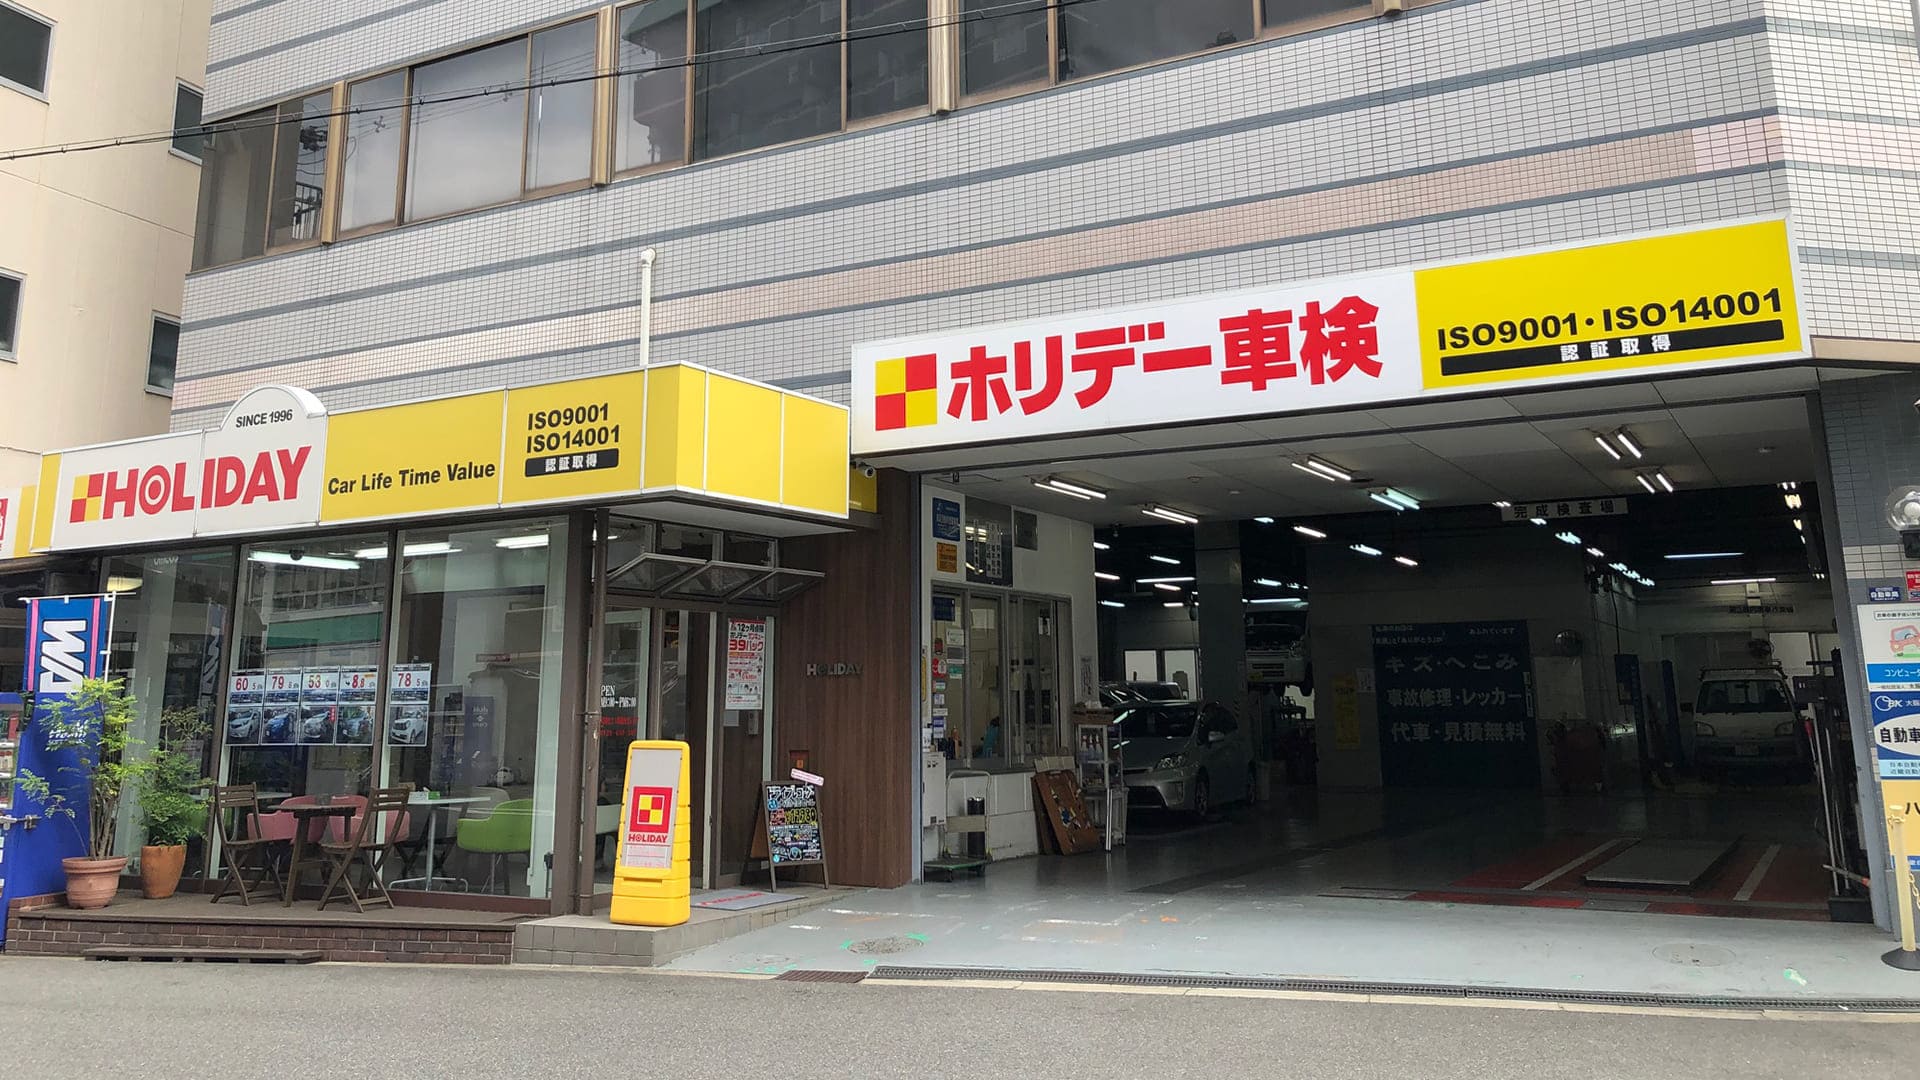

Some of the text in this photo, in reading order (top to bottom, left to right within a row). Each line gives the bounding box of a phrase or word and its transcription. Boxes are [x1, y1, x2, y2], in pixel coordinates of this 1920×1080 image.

[1560, 334, 1672, 362] 認証取得
[946, 295, 1384, 421] ホリデー車検
[235, 409, 294, 428] SINCE 1996
[527, 403, 609, 431] ISO9001
[526, 425, 620, 453] ISO14001
[545, 453, 598, 473] 認証取得
[102, 446, 312, 520] HOLIDAY
[328, 462, 496, 495] Car Life Time Value
[1514, 500, 1615, 518] 完成検査場
[806, 662, 864, 676] HOLIDAY
[235, 678, 249, 691] 60
[271, 676, 285, 690] 79
[308, 675, 321, 688] 53
[398, 673, 412, 687] 78
[600, 685, 616, 697] PEN
[1387, 687, 1522, 707] 事故修理・レッカー
[1391, 721, 1527, 743] 代車・見積無料
[628, 833, 668, 843] HOLIDAY
